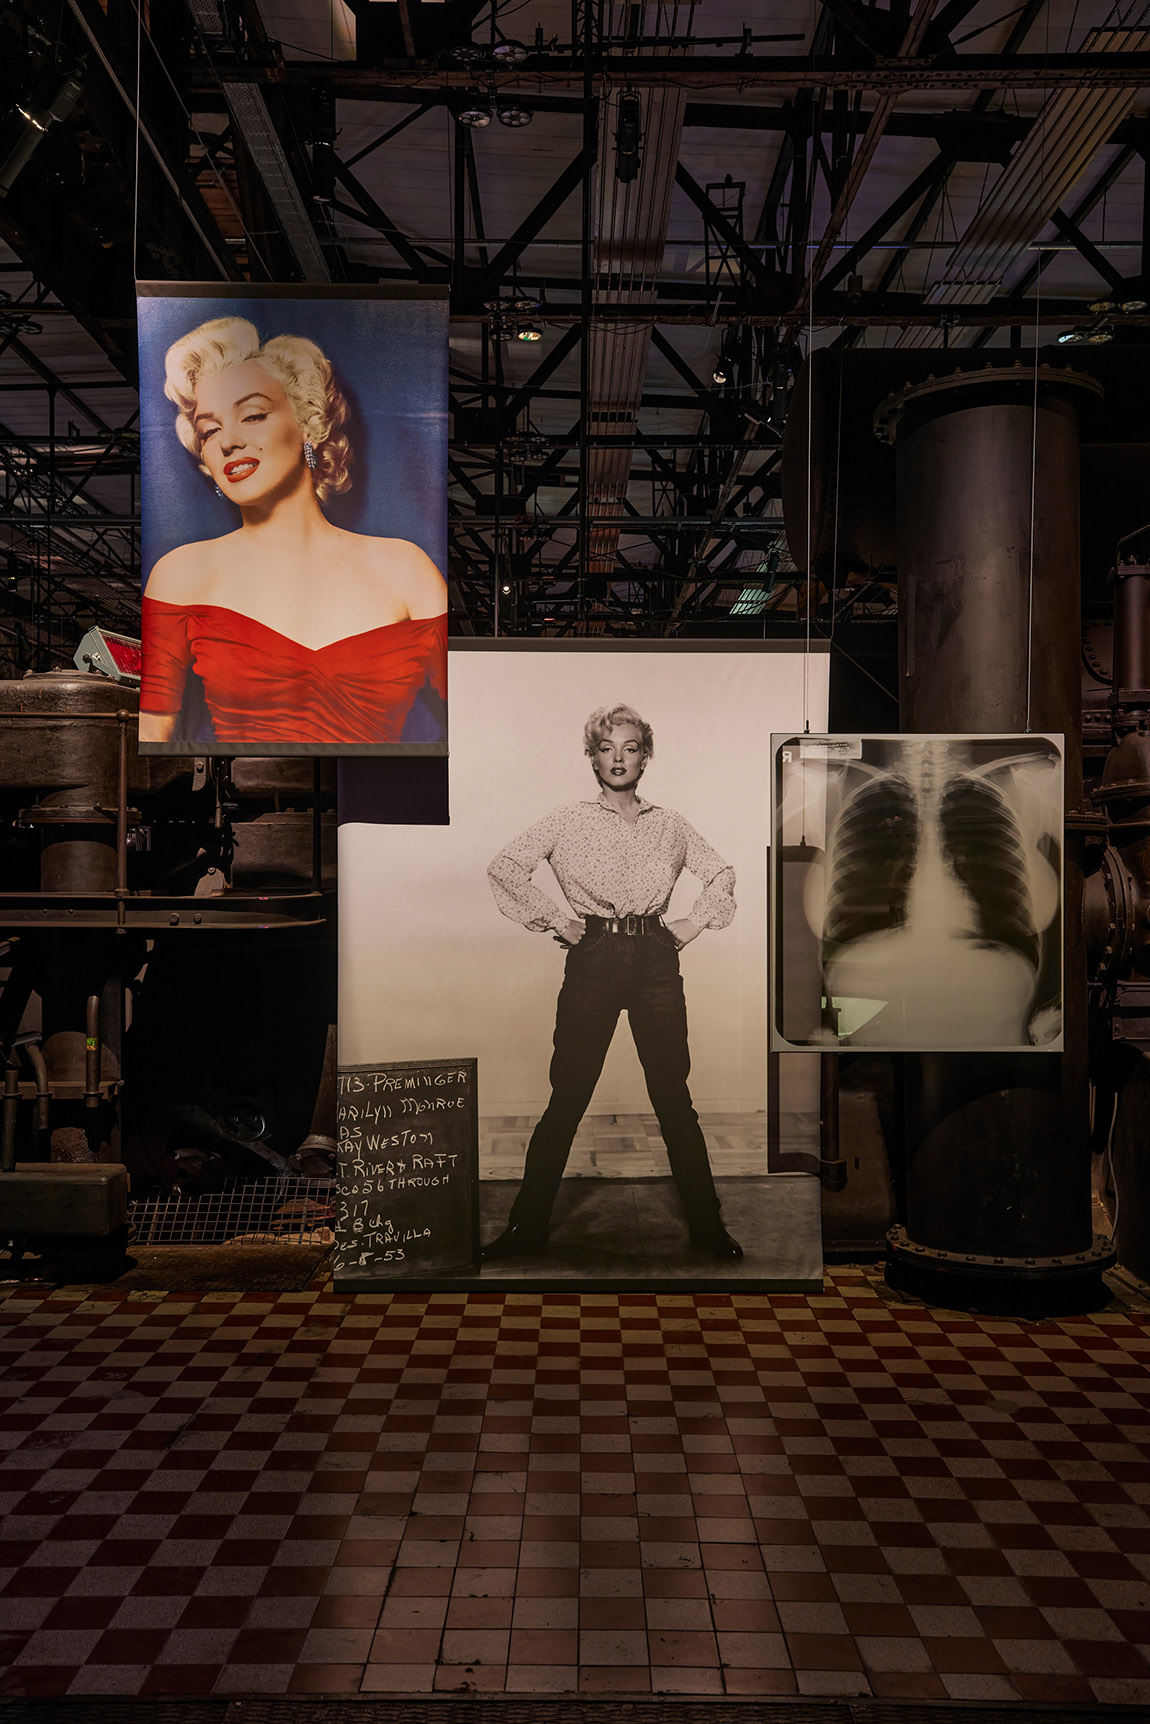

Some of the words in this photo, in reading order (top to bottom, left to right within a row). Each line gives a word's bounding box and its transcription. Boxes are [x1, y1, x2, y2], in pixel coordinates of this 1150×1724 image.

[336, 1100, 392, 1125] ARILYN
[400, 1097, 465, 1115] MONROE
[340, 1125, 362, 1140] AS
[366, 1129, 433, 1151] WESTON
[412, 1153, 458, 1170] RAFT
[389, 1174, 450, 1190] THROUGH
[340, 1199, 368, 1221] 317
